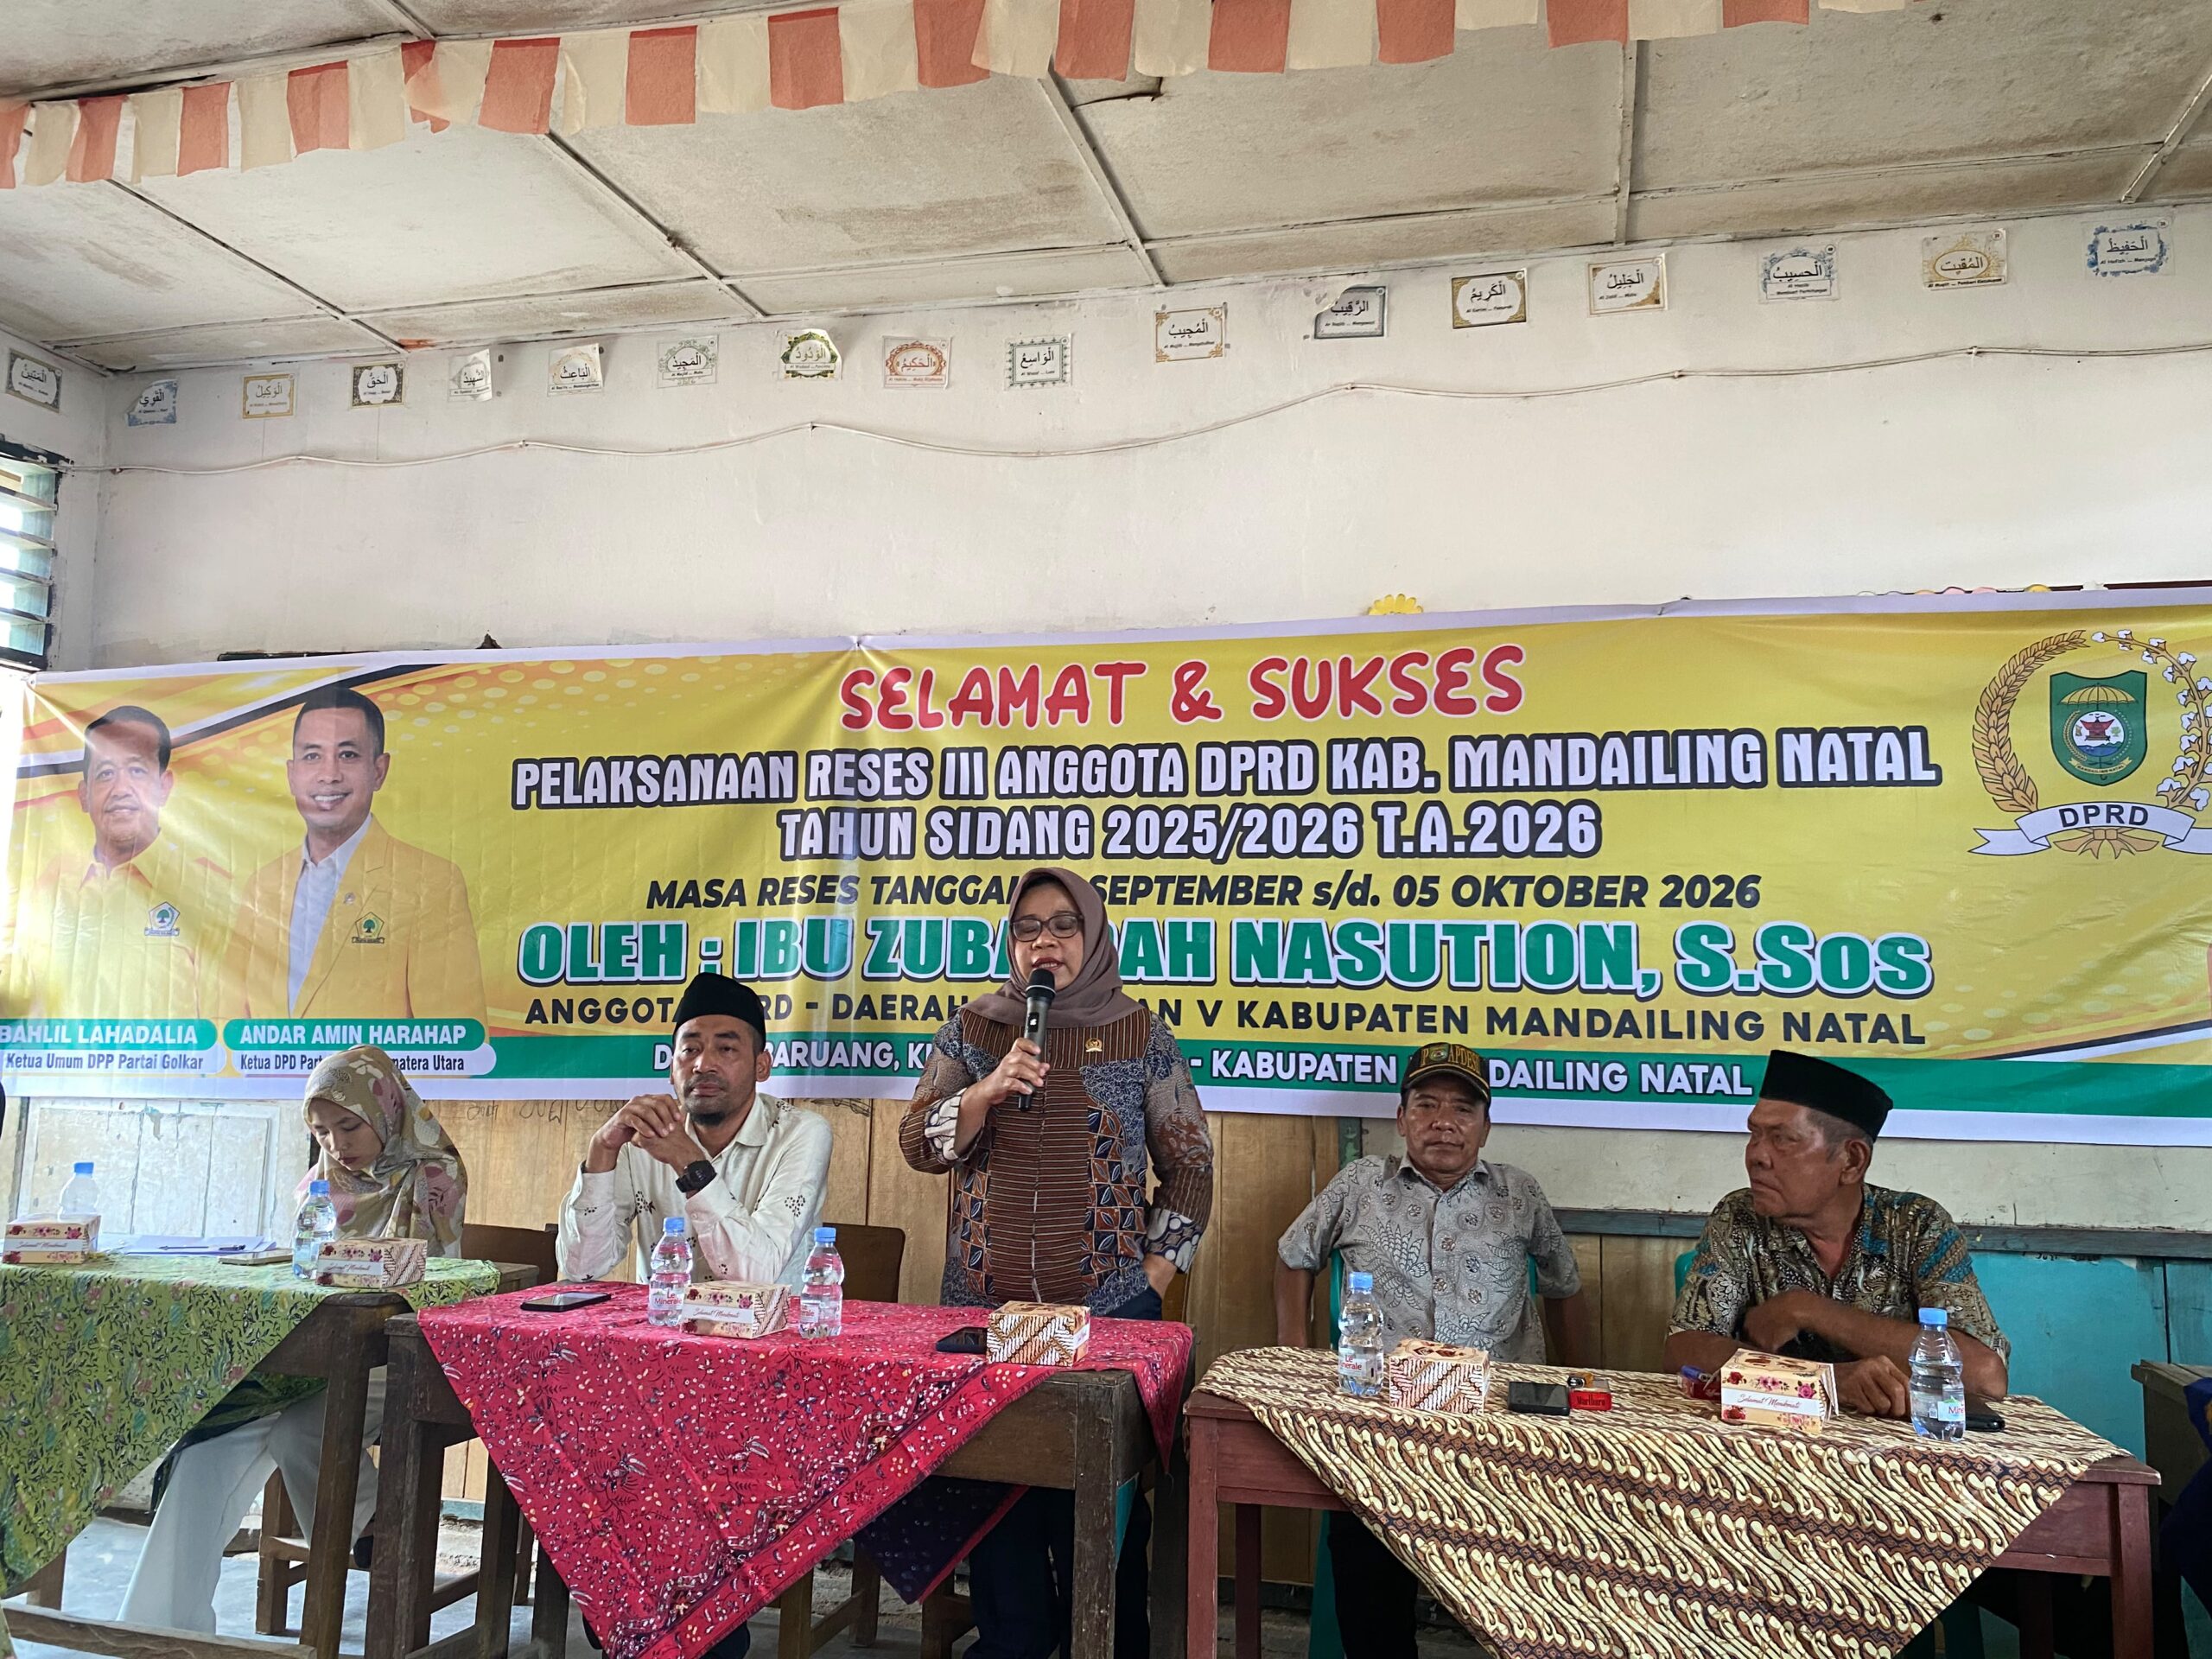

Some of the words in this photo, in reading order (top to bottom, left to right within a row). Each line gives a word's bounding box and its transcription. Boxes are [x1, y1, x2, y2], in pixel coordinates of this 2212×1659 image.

[840, 660, 1147, 733] SELAMAT
[1170, 660, 1223, 724] &
[1249, 644, 1526, 721] SUKSES
[512, 750, 798, 810] PELAKSANAAN
[805, 747, 932, 802] RESES
[940, 746, 988, 800] III
[996, 742, 1185, 800] ANGGOTA
[1195, 738, 1319, 796] DPRD
[1326, 736, 1437, 795] KAB.
[1449, 728, 1768, 792] MANDAILING
[1775, 726, 1942, 788] NATAL
[2058, 804, 2149, 828] DPRD
[778, 807, 918, 861] TAHUN
[925, 804, 1094, 861] SIDANG
[1102, 798, 1365, 864] 2025/2026
[1376, 797, 1604, 860] T.A.2026
[646, 878, 747, 909] MASA
[757, 874, 860, 907] RESES
[1095, 874, 1303, 907] SEPTEMBER
[1313, 868, 1381, 909] s/d.
[1393, 874, 1440, 908] 05
[1451, 874, 1649, 909] OKTOBER
[1659, 874, 1762, 909] 2026
[518, 920, 690, 987] OLEH
[732, 914, 853, 984] IBU
[1229, 918, 1662, 1002] NASUTION,
[525, 997, 676, 1025] ANGGOT
[1197, 1000, 1224, 1027] V
[1237, 1000, 1469, 1034] KABUPATEN
[1486, 1006, 1764, 1041] MANDAILING
[1783, 1012, 1926, 1044] NATAL
[0, 1025, 73, 1045] BAHLIL
[78, 1025, 198, 1045] LAHADALIA
[240, 1025, 306, 1044] ANDAR
[312, 1025, 362, 1044] AMIN
[369, 1025, 467, 1045] HARAHAP
[5, 1052, 43, 1070] Ketua
[47, 1052, 84, 1069] Umum
[88, 1052, 115, 1069] DPP
[118, 1052, 158, 1070] Partai
[162, 1052, 204, 1070] Golkar
[241, 1053, 270, 1070] Ketua
[274, 1053, 296, 1070] DPD
[300, 1053, 323, 1070] Part
[433, 1054, 464, 1071] Utara
[1211, 1049, 1398, 1084] KABUPATEN
[1488, 1058, 1629, 1093] DAILING
[1640, 1063, 1754, 1096] NATAL
[654, 1297, 683, 1306] Minerale
[667, 1287, 677, 1299] Le
